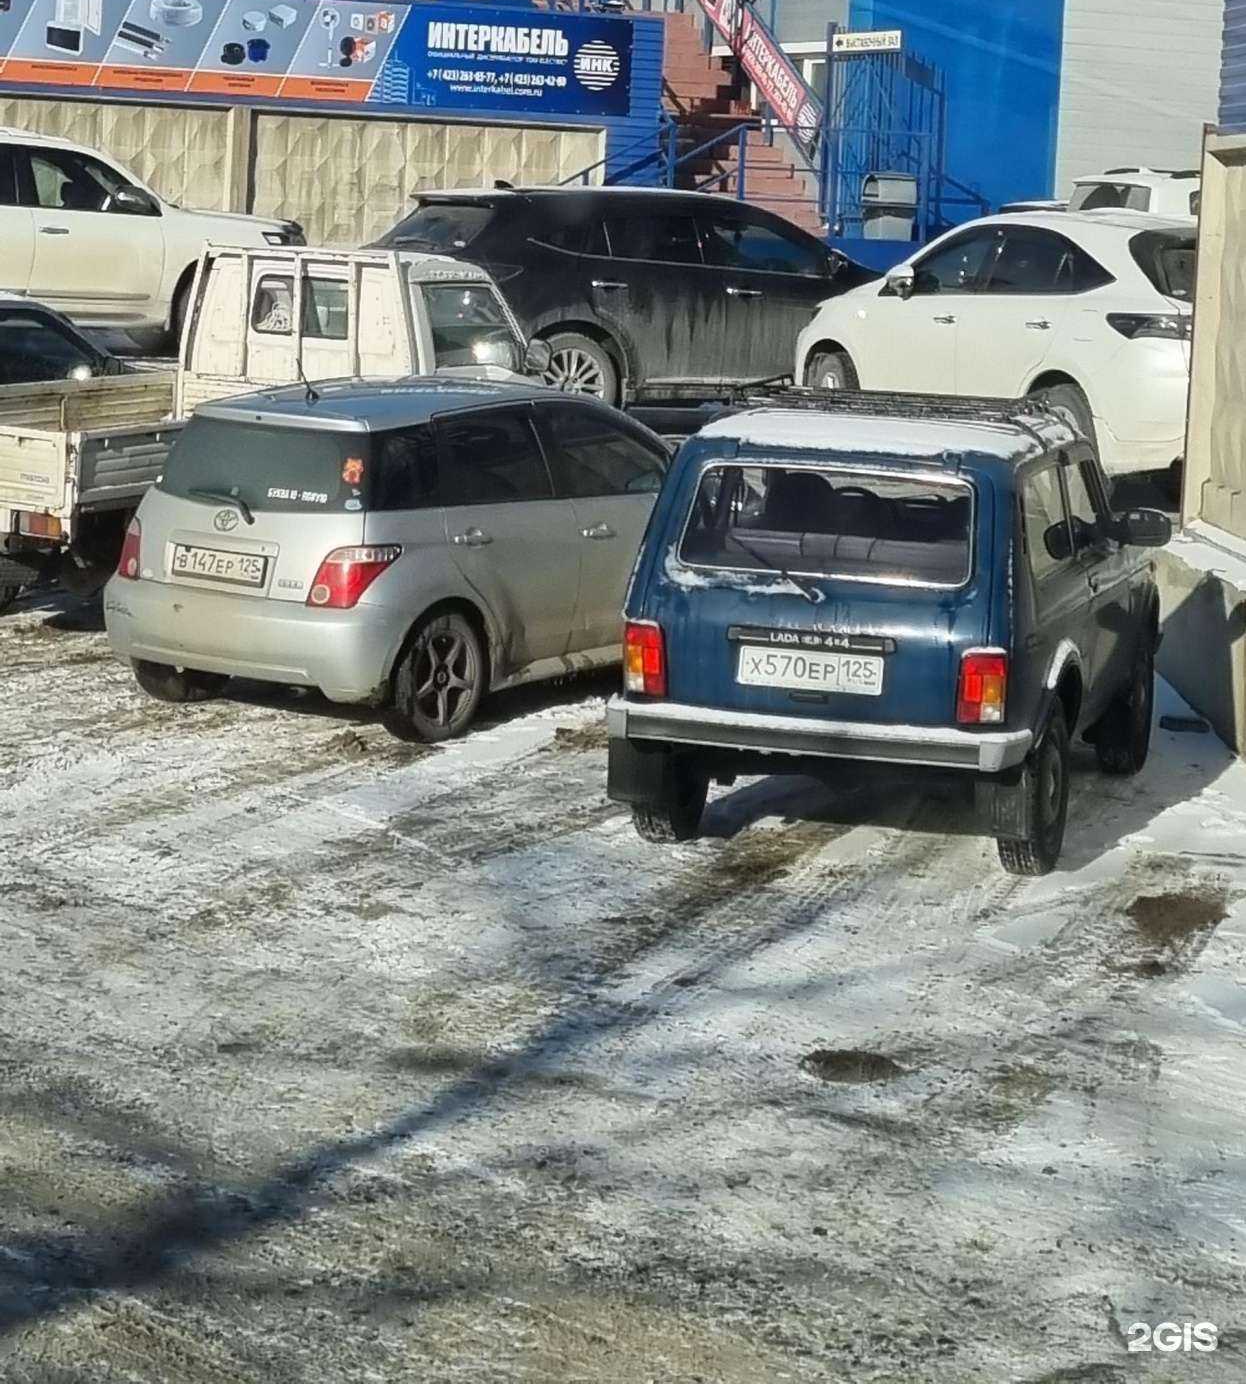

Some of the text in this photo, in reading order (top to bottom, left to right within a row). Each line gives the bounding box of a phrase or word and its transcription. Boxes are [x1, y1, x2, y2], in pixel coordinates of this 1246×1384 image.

[428, 22, 569, 56] ИНТЕРКАБЕЛЬ
[580, 57, 613, 72] ИНК
[239, 558, 259, 574] 125
[770, 632, 800, 644] LADA
[841, 659, 875, 679] 125
